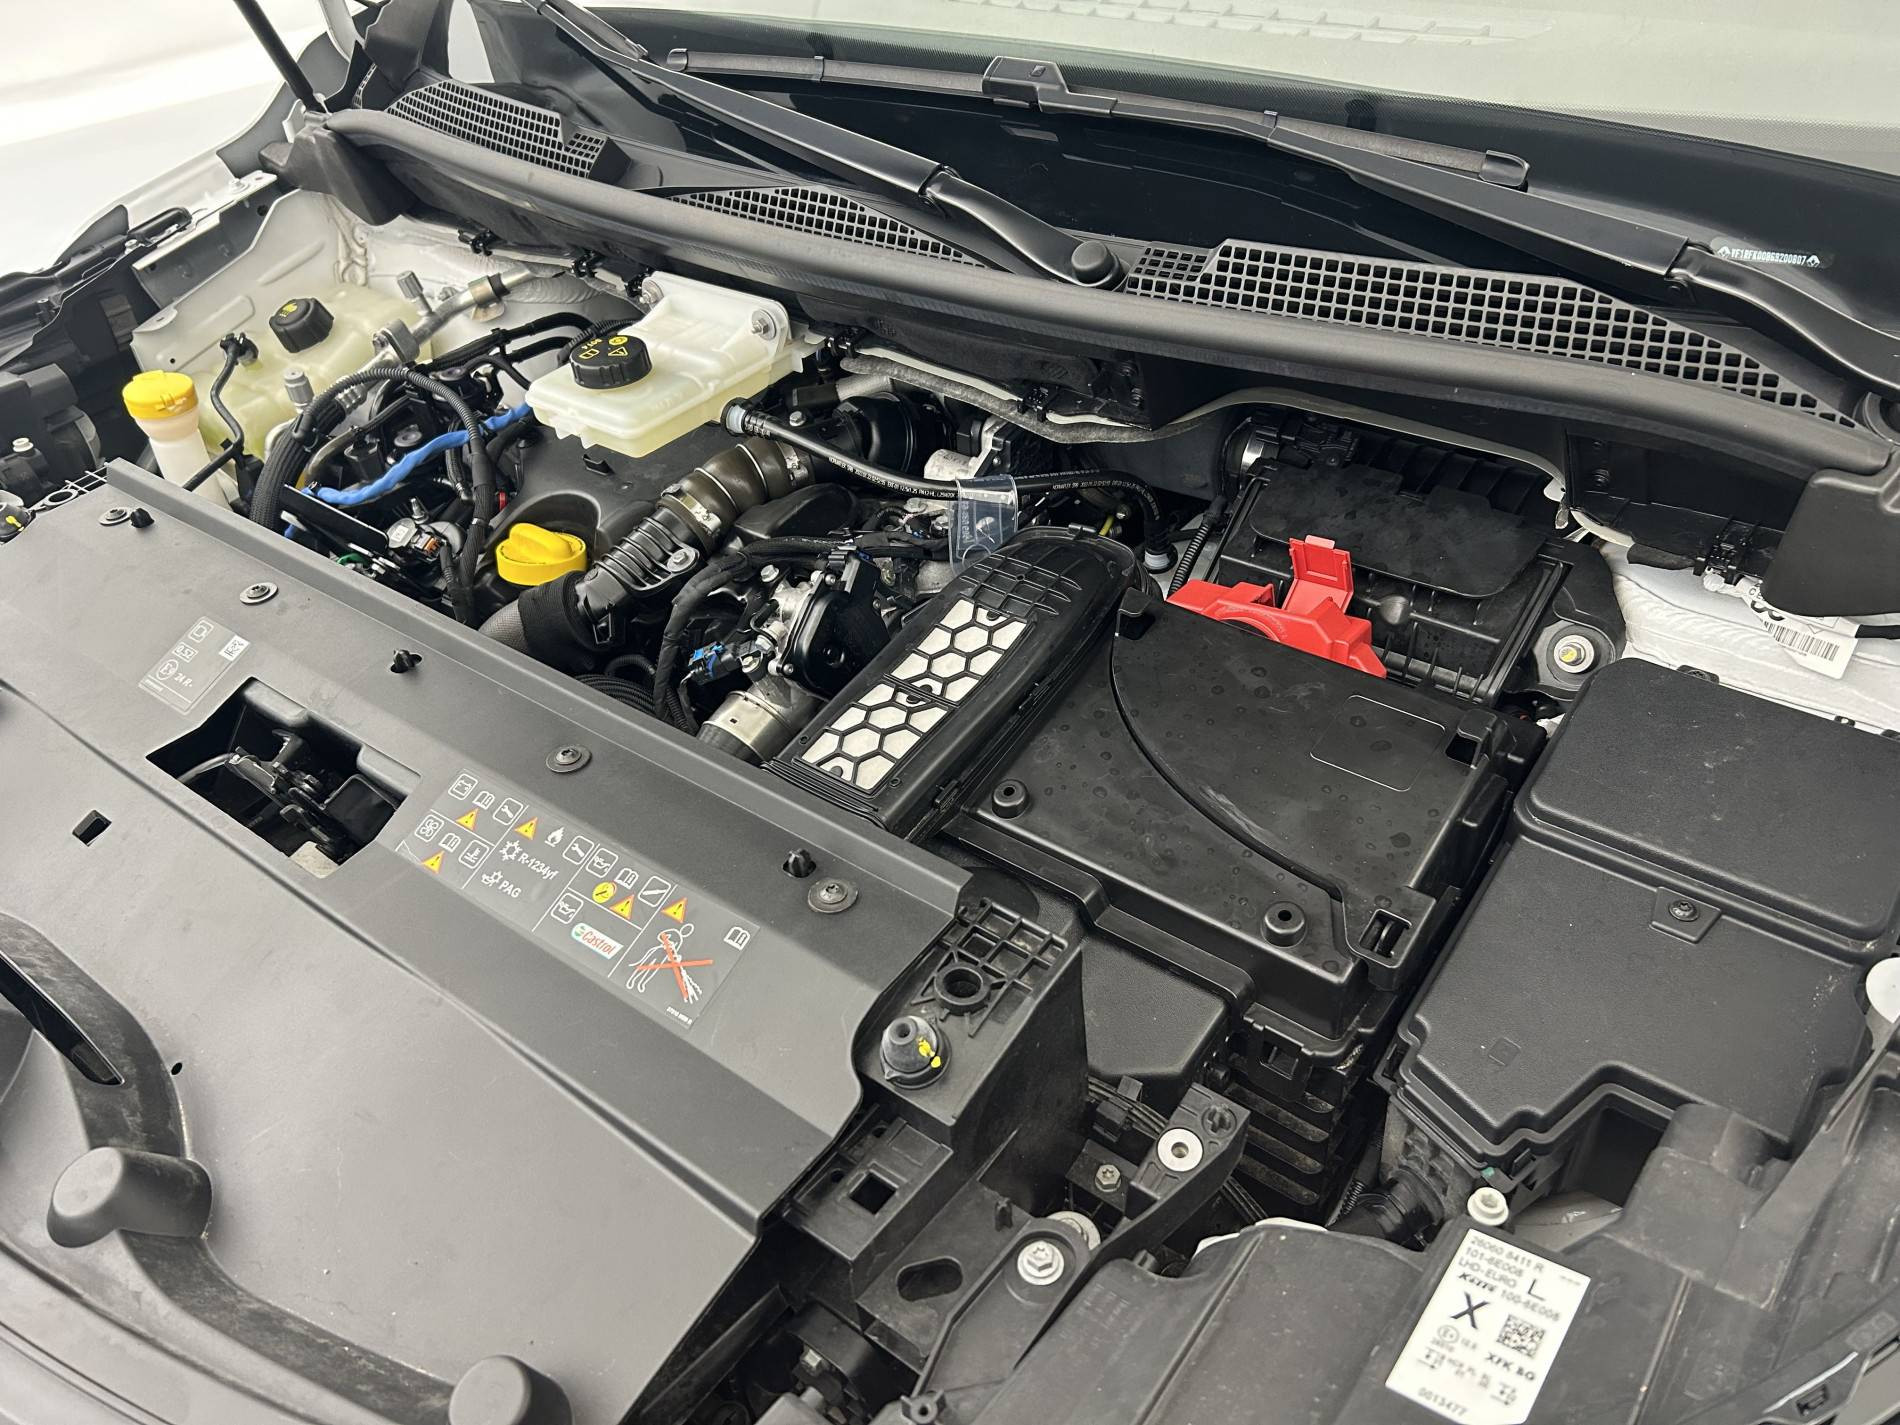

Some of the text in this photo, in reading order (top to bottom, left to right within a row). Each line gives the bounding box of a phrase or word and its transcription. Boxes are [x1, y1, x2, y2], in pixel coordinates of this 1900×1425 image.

[518, 853, 560, 880] R-1234yf
[498, 880, 522, 898] PAG
[582, 931, 616, 955] Castrol
[1527, 1278, 1546, 1301] L
[1450, 1291, 1490, 1330] X
